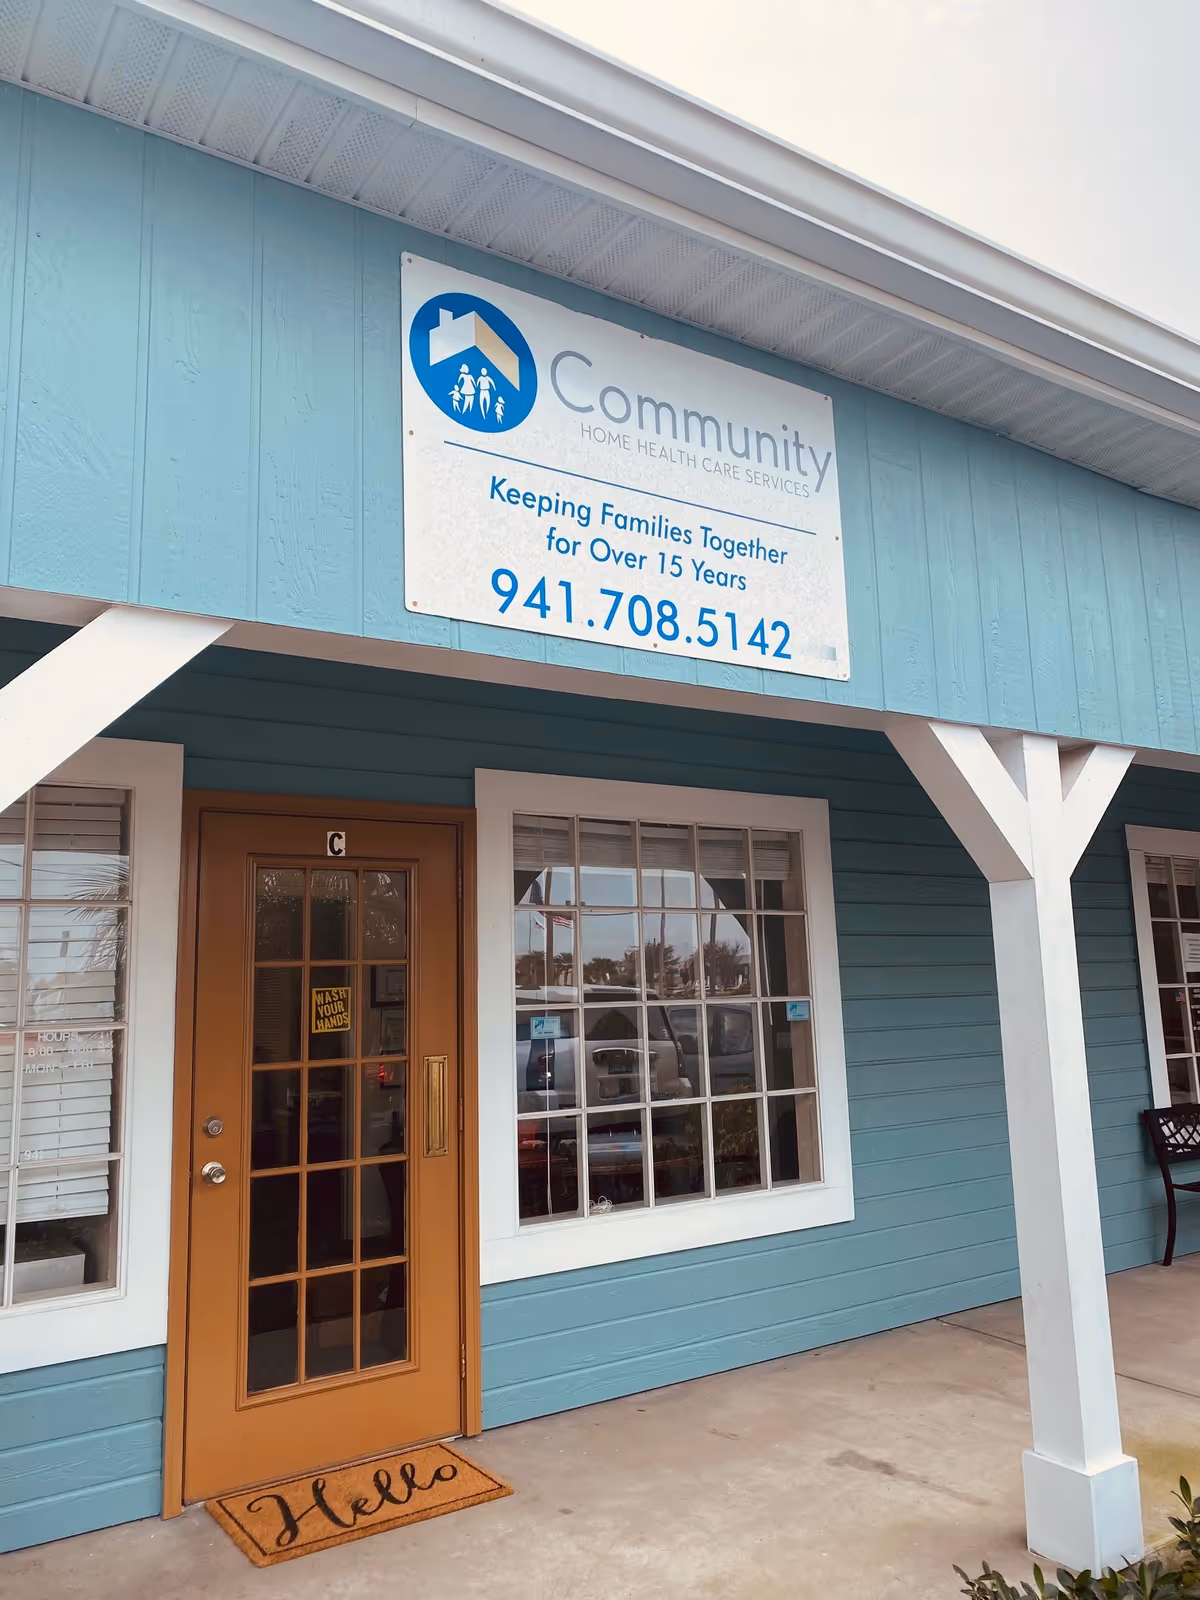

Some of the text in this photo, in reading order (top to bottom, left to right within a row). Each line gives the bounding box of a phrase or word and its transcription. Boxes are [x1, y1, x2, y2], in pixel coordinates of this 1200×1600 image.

[550, 350, 833, 492] Community
[580, 423, 810, 499] HOME HEALTH CARE SERVICES
[489, 475, 788, 565] Keeping Families Together
[546, 527, 747, 591] for Over 15 Years
[490, 567, 793, 661] 941.708.5142
[329, 833, 343, 855] C
[315, 988, 346, 1005] WASH
[316, 1012, 349, 1030] HANDS
[317, 1001, 345, 1018] YOUR
[25, 1063, 55, 1074] MON
[246, 1462, 458, 1548] Hello
